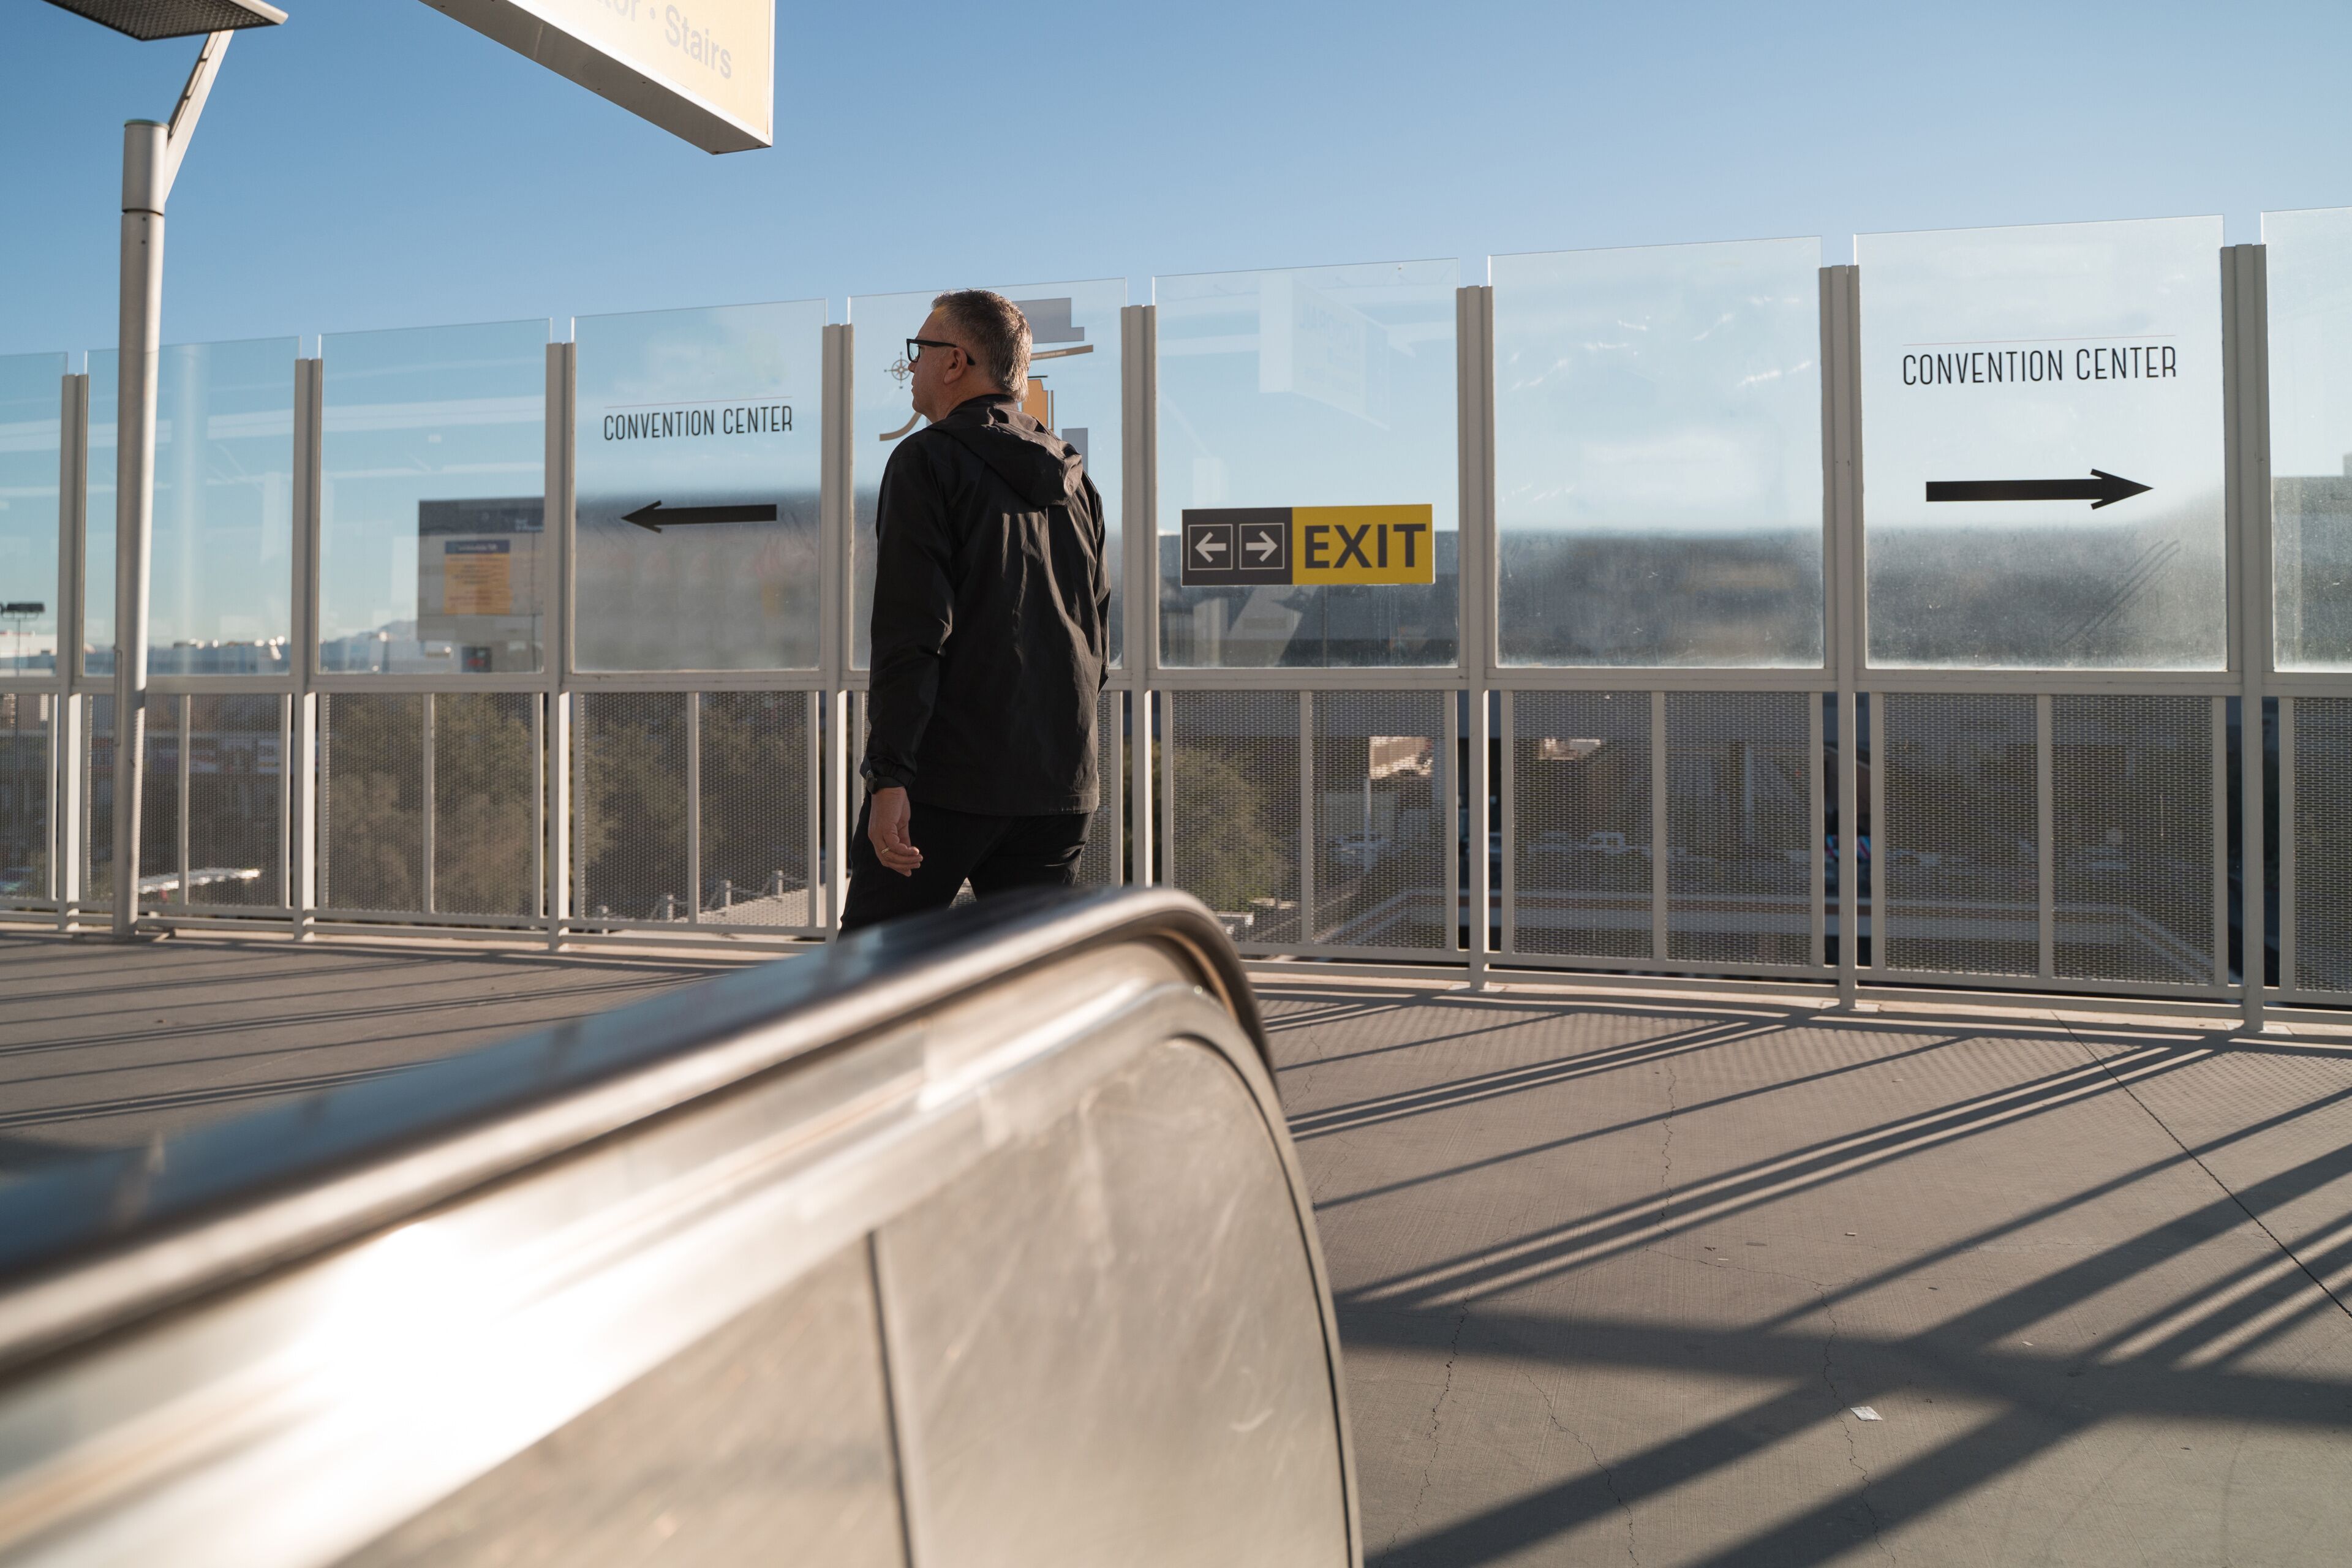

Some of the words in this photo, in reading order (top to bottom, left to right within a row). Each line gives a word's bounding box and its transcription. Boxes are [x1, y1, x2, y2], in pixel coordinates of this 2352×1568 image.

[665, 4, 732, 80] Stairs
[1902, 349, 2063, 385] CONVENTION
[2076, 345, 2177, 380] CENTER
[604, 409, 714, 441] CONVENTION
[723, 405, 793, 434] CENTER
[1304, 522, 1427, 569] EXIT
